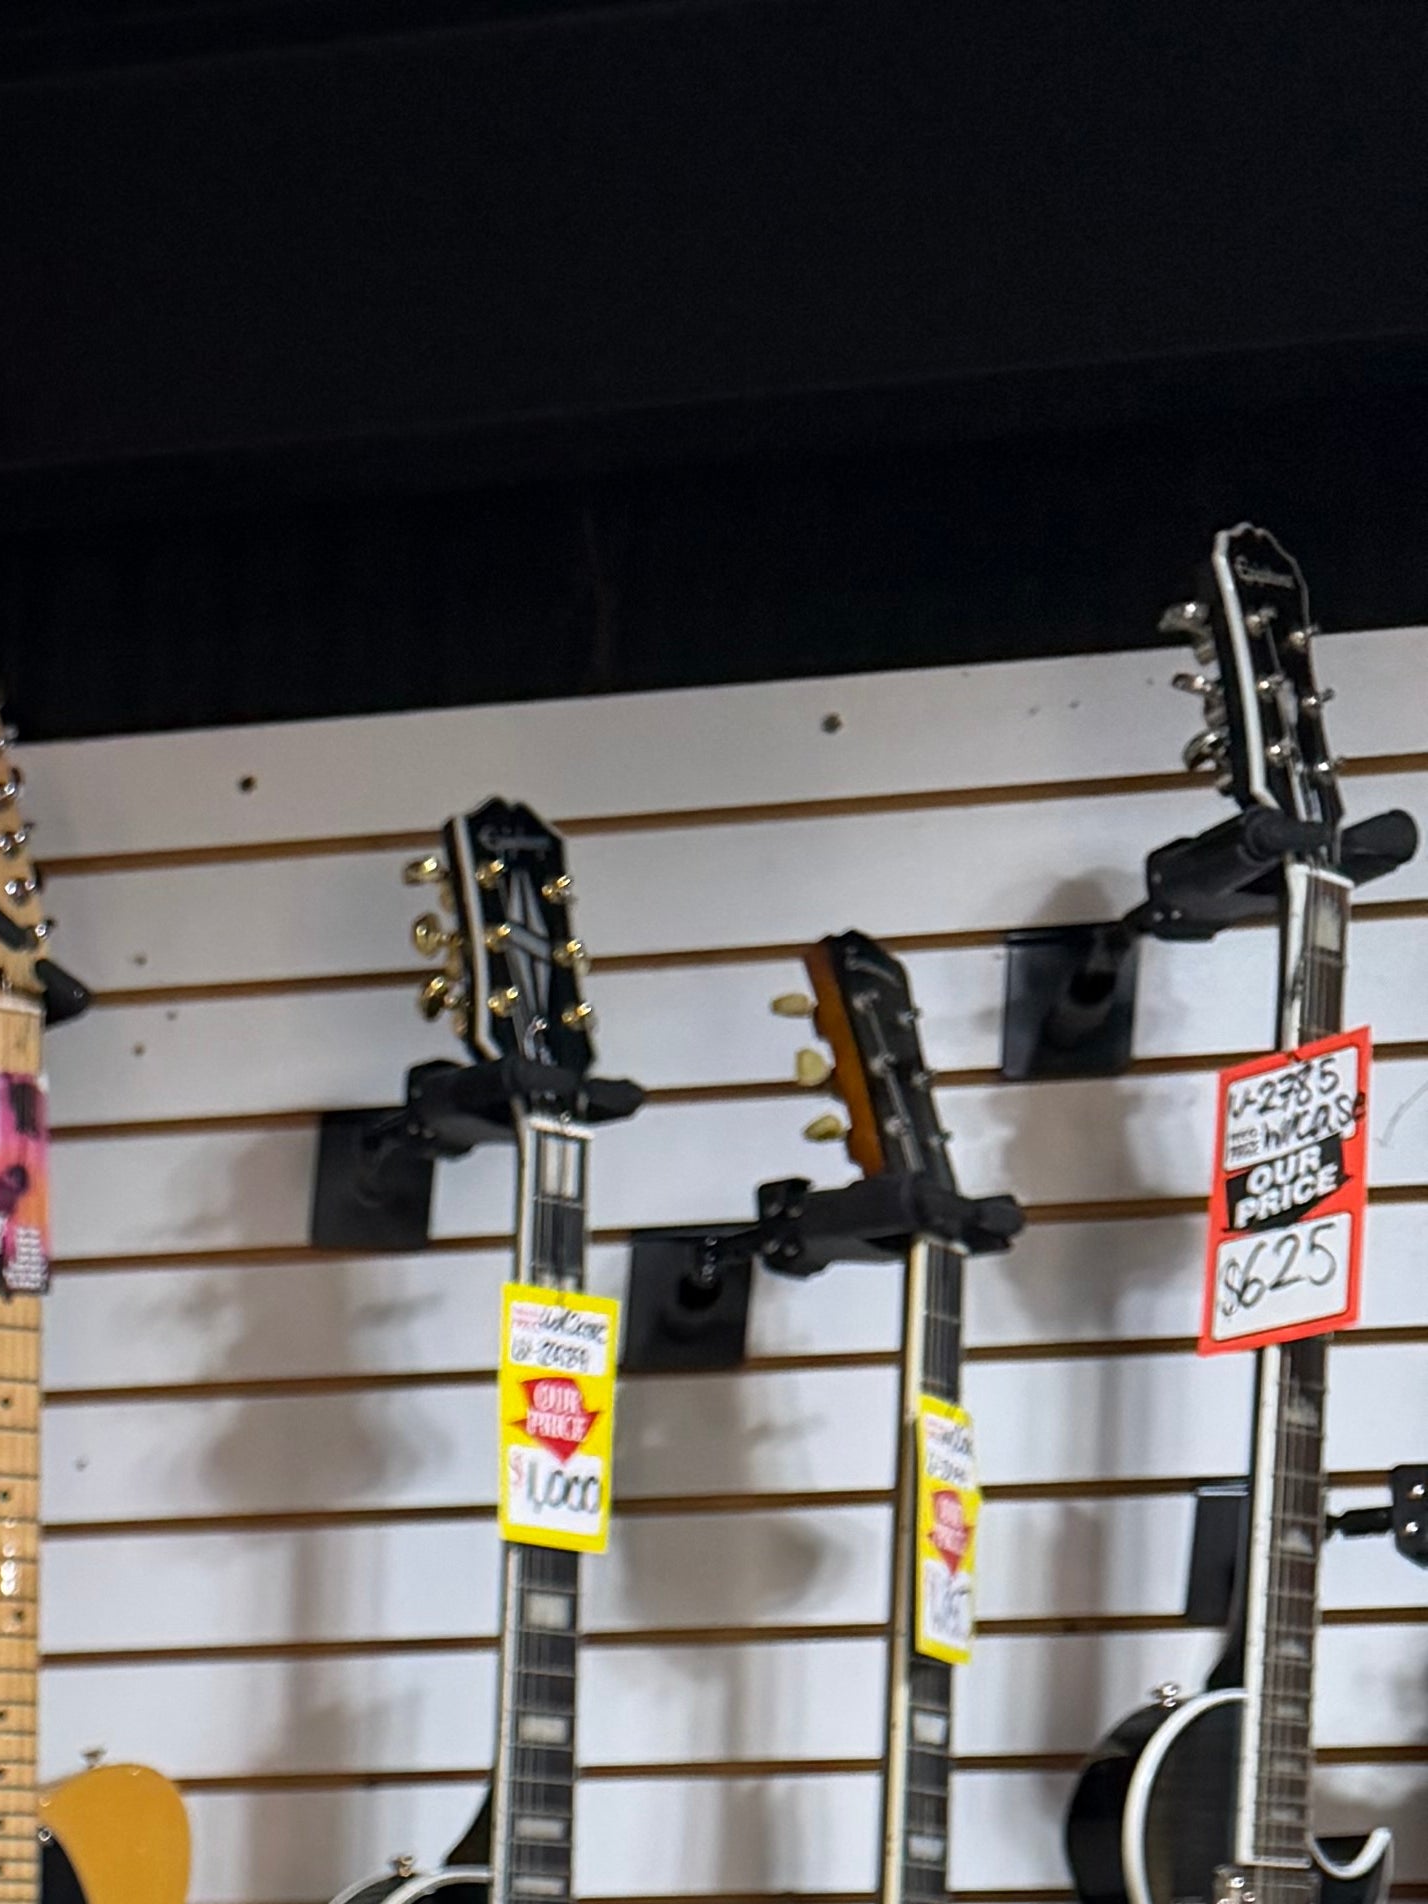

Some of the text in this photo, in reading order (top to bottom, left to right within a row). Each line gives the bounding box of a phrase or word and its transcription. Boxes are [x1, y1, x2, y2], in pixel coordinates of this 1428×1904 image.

[1235, 1163, 1338, 1228] PRICE
[1246, 1145, 1322, 1196] OUR
[1221, 1222, 1336, 1317] $625
